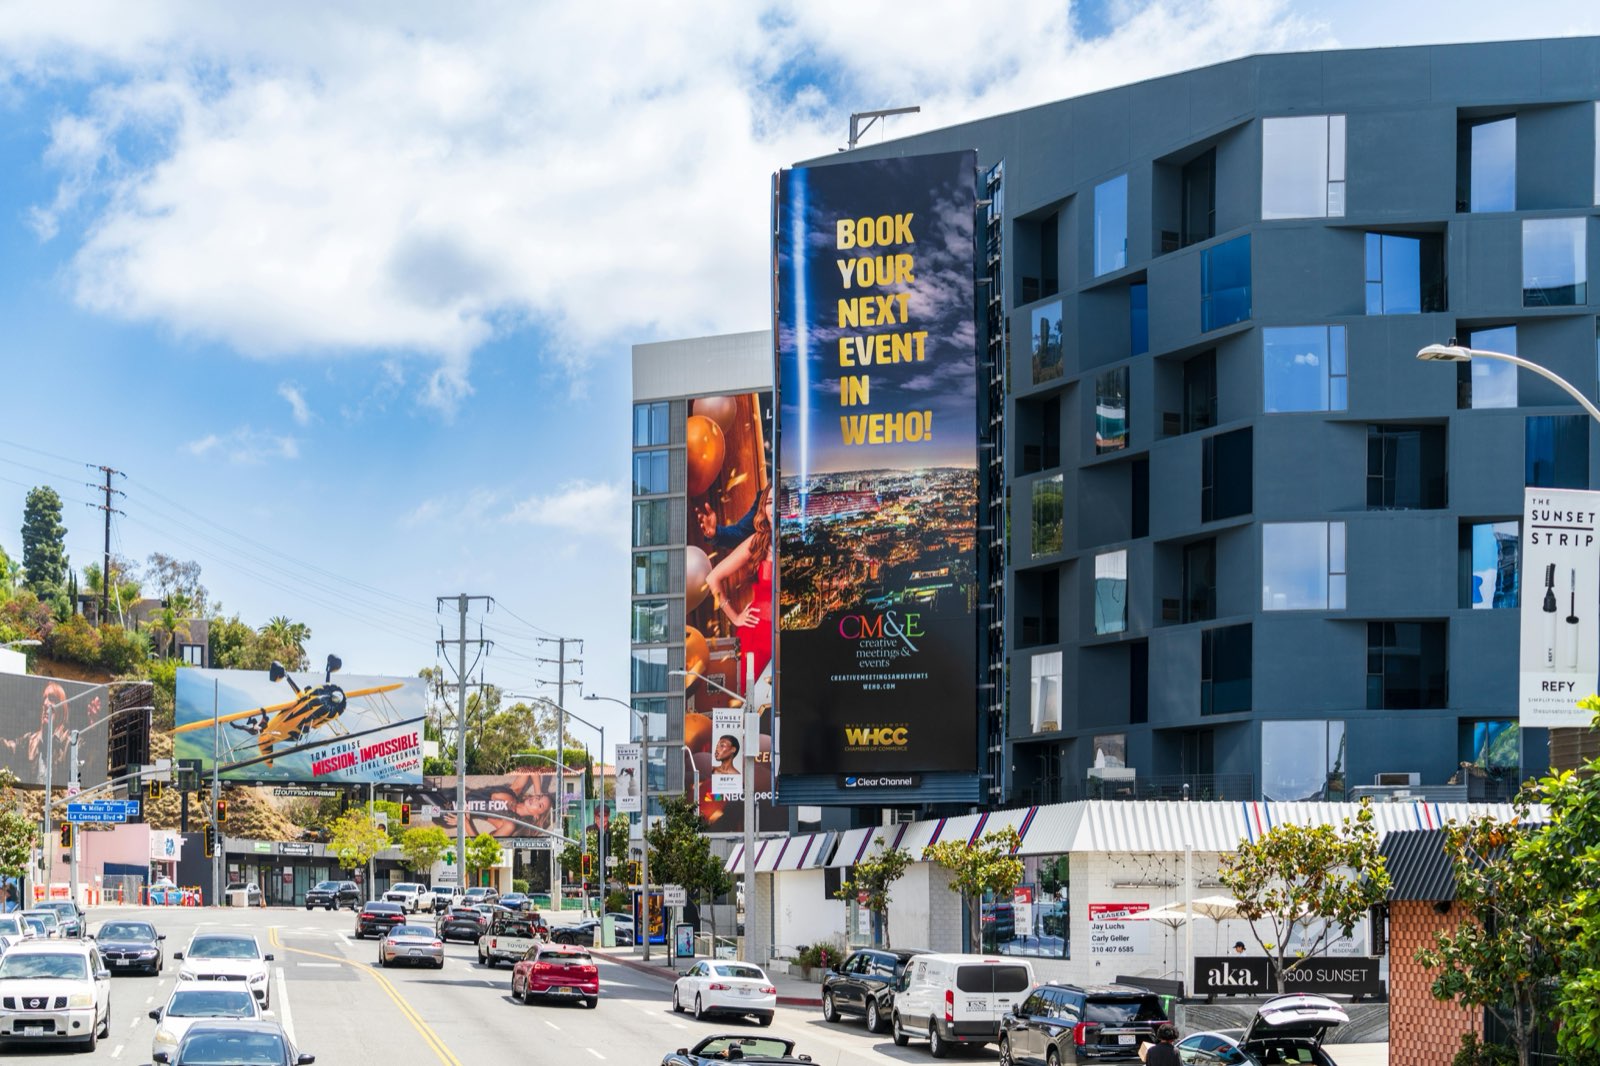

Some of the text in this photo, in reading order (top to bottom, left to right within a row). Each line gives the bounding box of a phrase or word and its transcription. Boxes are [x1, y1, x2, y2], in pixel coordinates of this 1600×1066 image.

[837, 213, 914, 250] BOOK
[836, 253, 914, 289] YOUR
[838, 293, 911, 328] NEXT
[839, 331, 928, 367] EVENT
[840, 375, 869, 407] IN
[841, 410, 933, 446] WEHO!
[1532, 509, 1595, 524] SUNSET
[1531, 532, 1594, 547] STRIP
[838, 610, 925, 652] CM&E
[860, 637, 897, 648] creative
[856, 646, 911, 659] meetings &
[859, 659, 890, 668] events
[830, 671, 928, 681] CREATIVEMEETINGSANDEVENTS
[1542, 681, 1575, 692] REFY
[845, 728, 909, 746] WHCC
[310, 740, 360, 761] TOM CRUISE
[312, 732, 419, 777] MISSION: IMPOSSIBLE
[755, 752, 771, 762] CE
[345, 747, 421, 776] THE FINAL RECKONING
[396, 759, 419, 770] IMAX
[857, 777, 912, 786] Clear Channel
[488, 801, 508, 811] FOX
[79, 813, 101, 822] Cienega
[1097, 911, 1126, 919] LEASED
[1092, 923, 1104, 931] Jay
[1207, 962, 1259, 986] aka.
[1316, 969, 1368, 982] SUNSET
